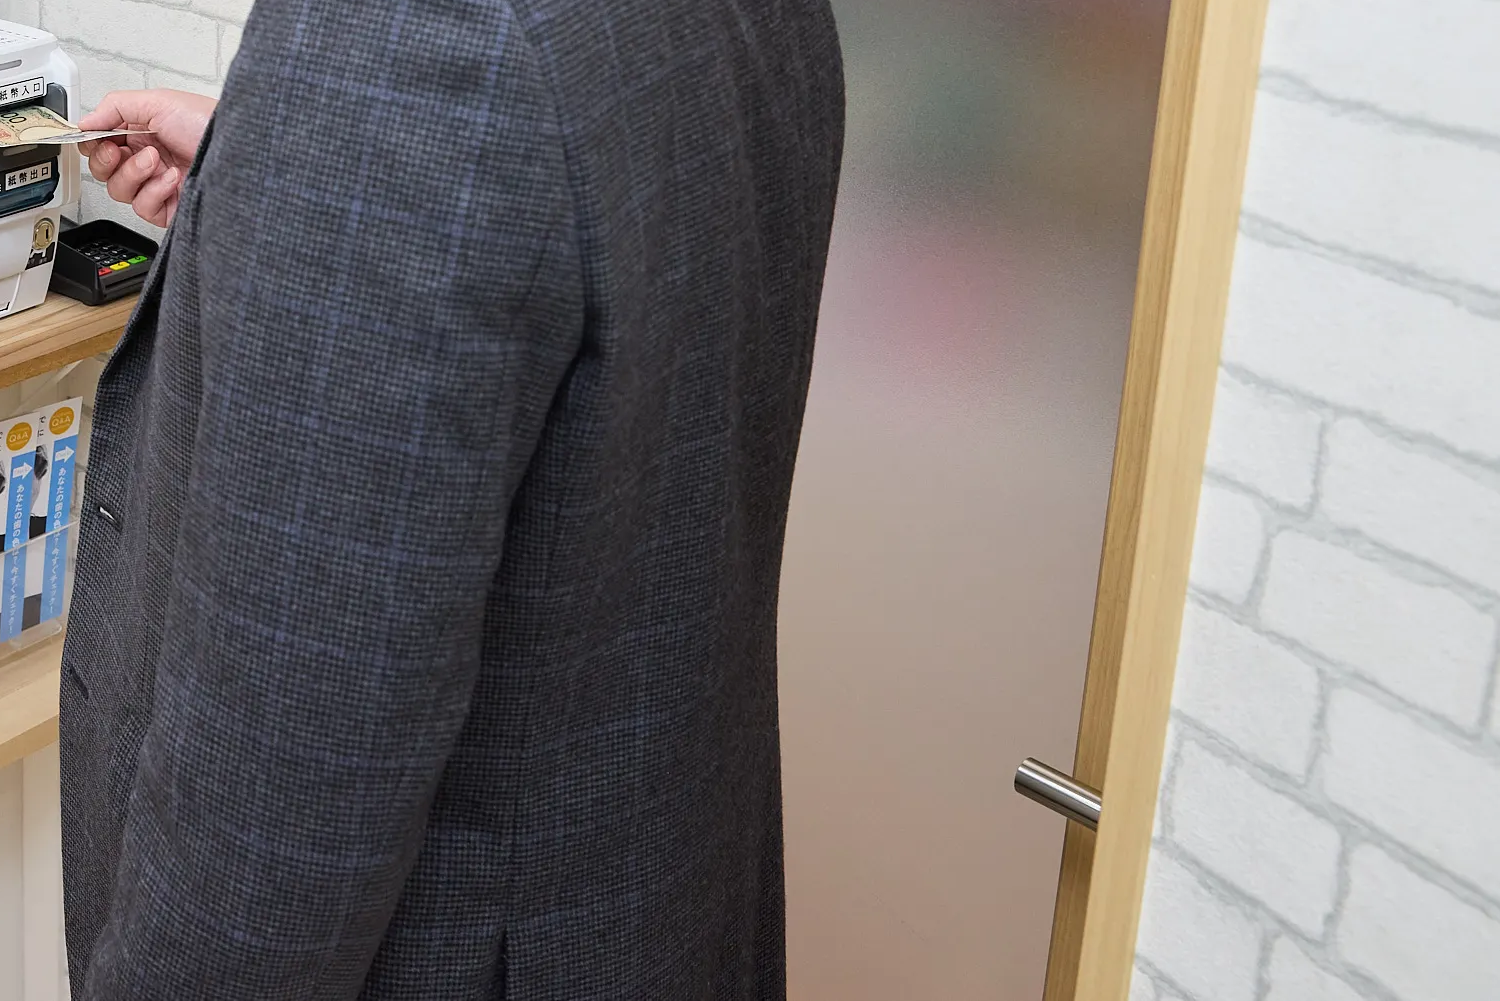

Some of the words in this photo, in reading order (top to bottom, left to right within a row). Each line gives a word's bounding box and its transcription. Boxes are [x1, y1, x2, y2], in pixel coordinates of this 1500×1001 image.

[7, 166, 50, 187] 紙幣出口
[50, 416, 71, 428] Q&A
[9, 431, 29, 443] Q&A
